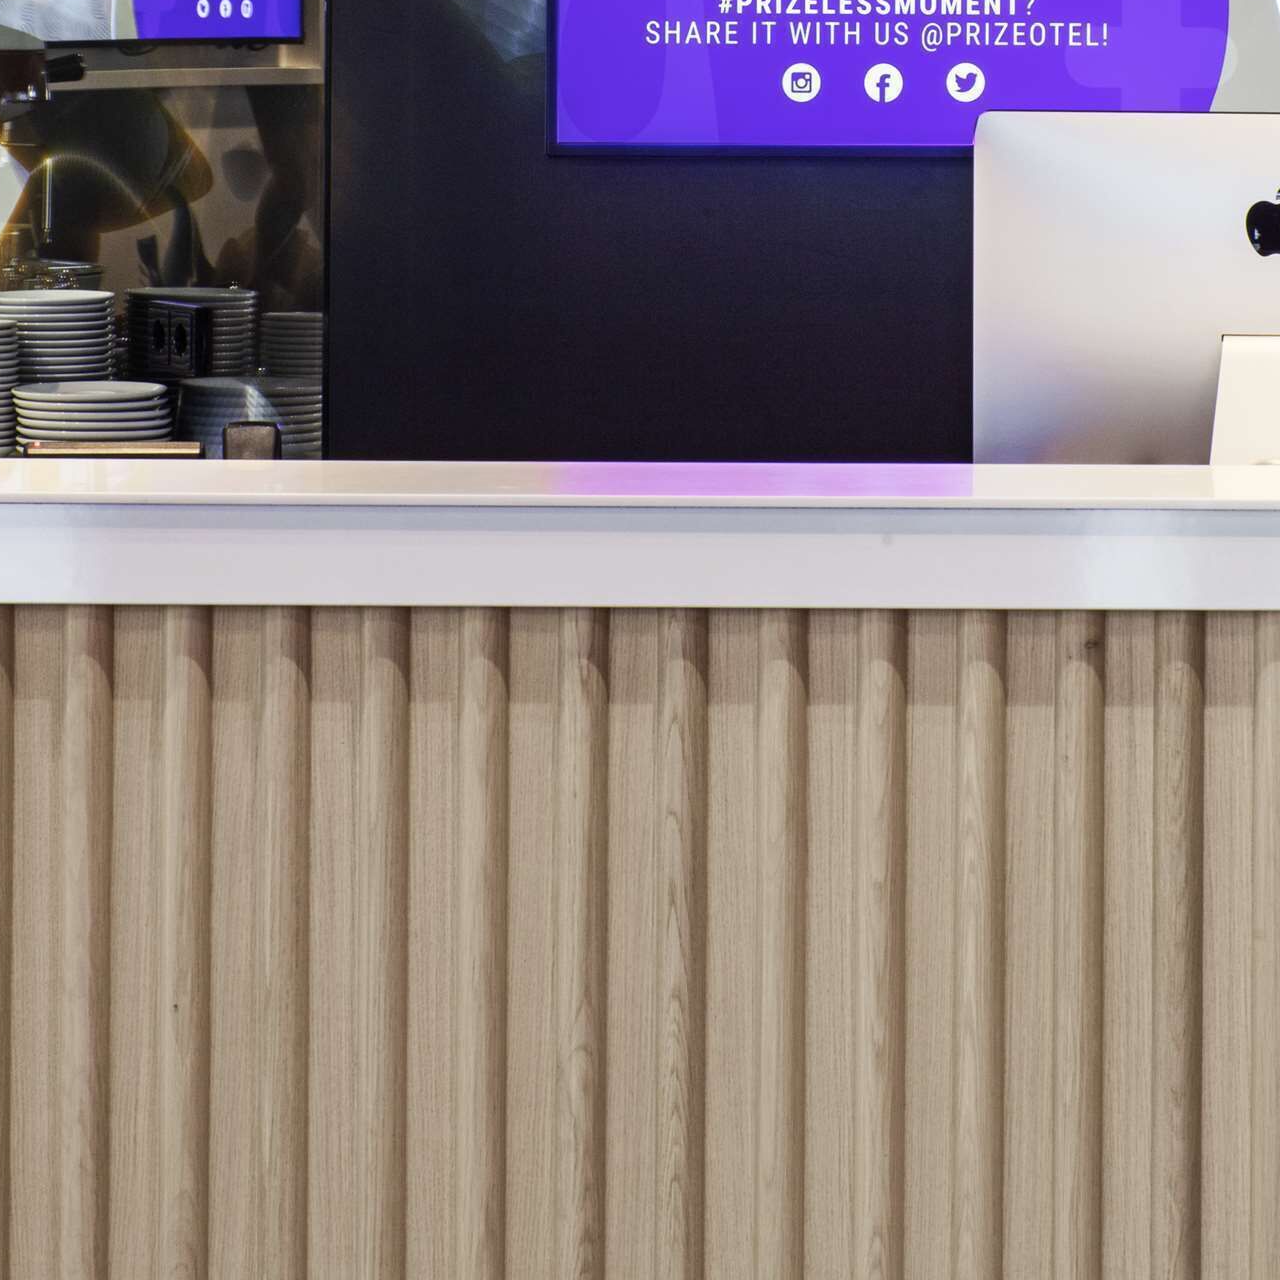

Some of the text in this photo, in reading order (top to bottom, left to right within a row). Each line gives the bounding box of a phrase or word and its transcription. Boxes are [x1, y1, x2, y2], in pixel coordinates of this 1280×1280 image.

[645, 20, 1109, 52] SHARE IT WITH US @PRIZEOTEL!
